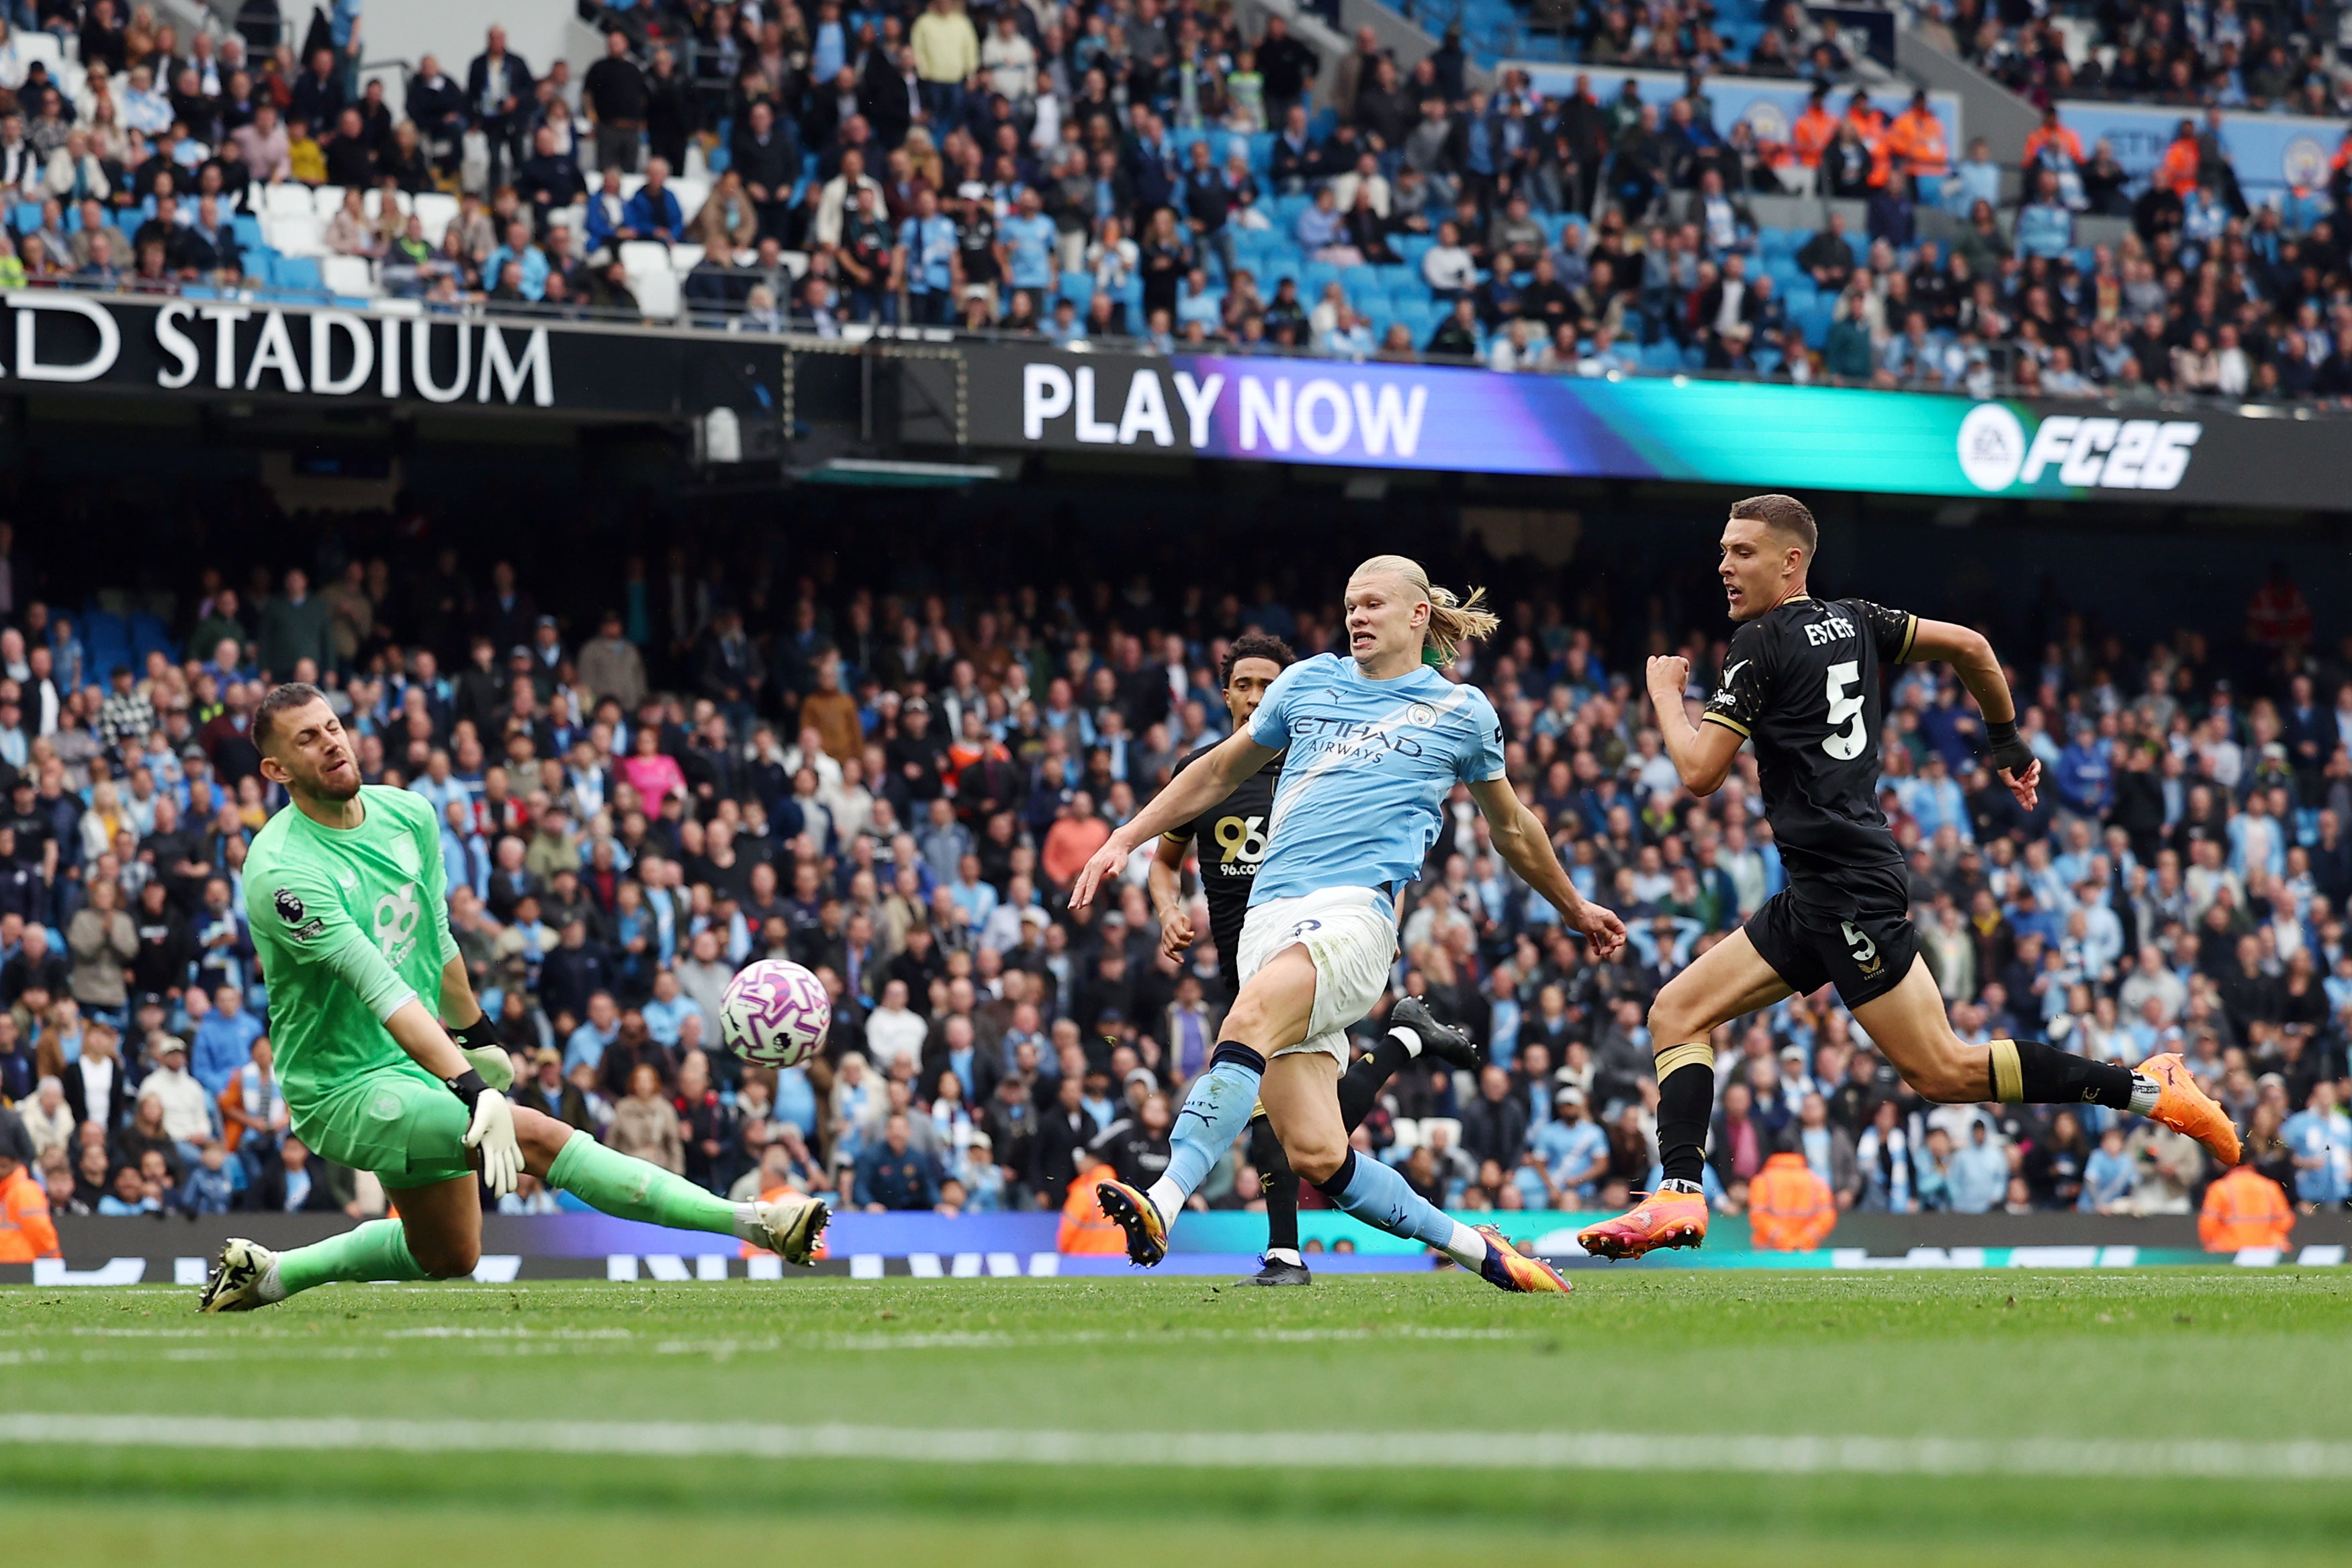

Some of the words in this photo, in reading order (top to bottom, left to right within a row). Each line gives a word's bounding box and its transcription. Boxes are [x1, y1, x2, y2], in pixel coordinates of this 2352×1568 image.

[0, 292, 121, 383] D
[155, 302, 554, 407] STADIUM
[1023, 363, 1225, 448] PLAY
[1238, 375, 1428, 457] NOW
[1715, 688, 1736, 706] Sure
[1821, 660, 1867, 760] 5
[1294, 717, 1422, 757] ETIHAD
[1309, 739, 1384, 764] AIRWAYS
[1214, 815, 1267, 863] 96
[373, 880, 420, 958] 96
[1841, 921, 1876, 961] 5
